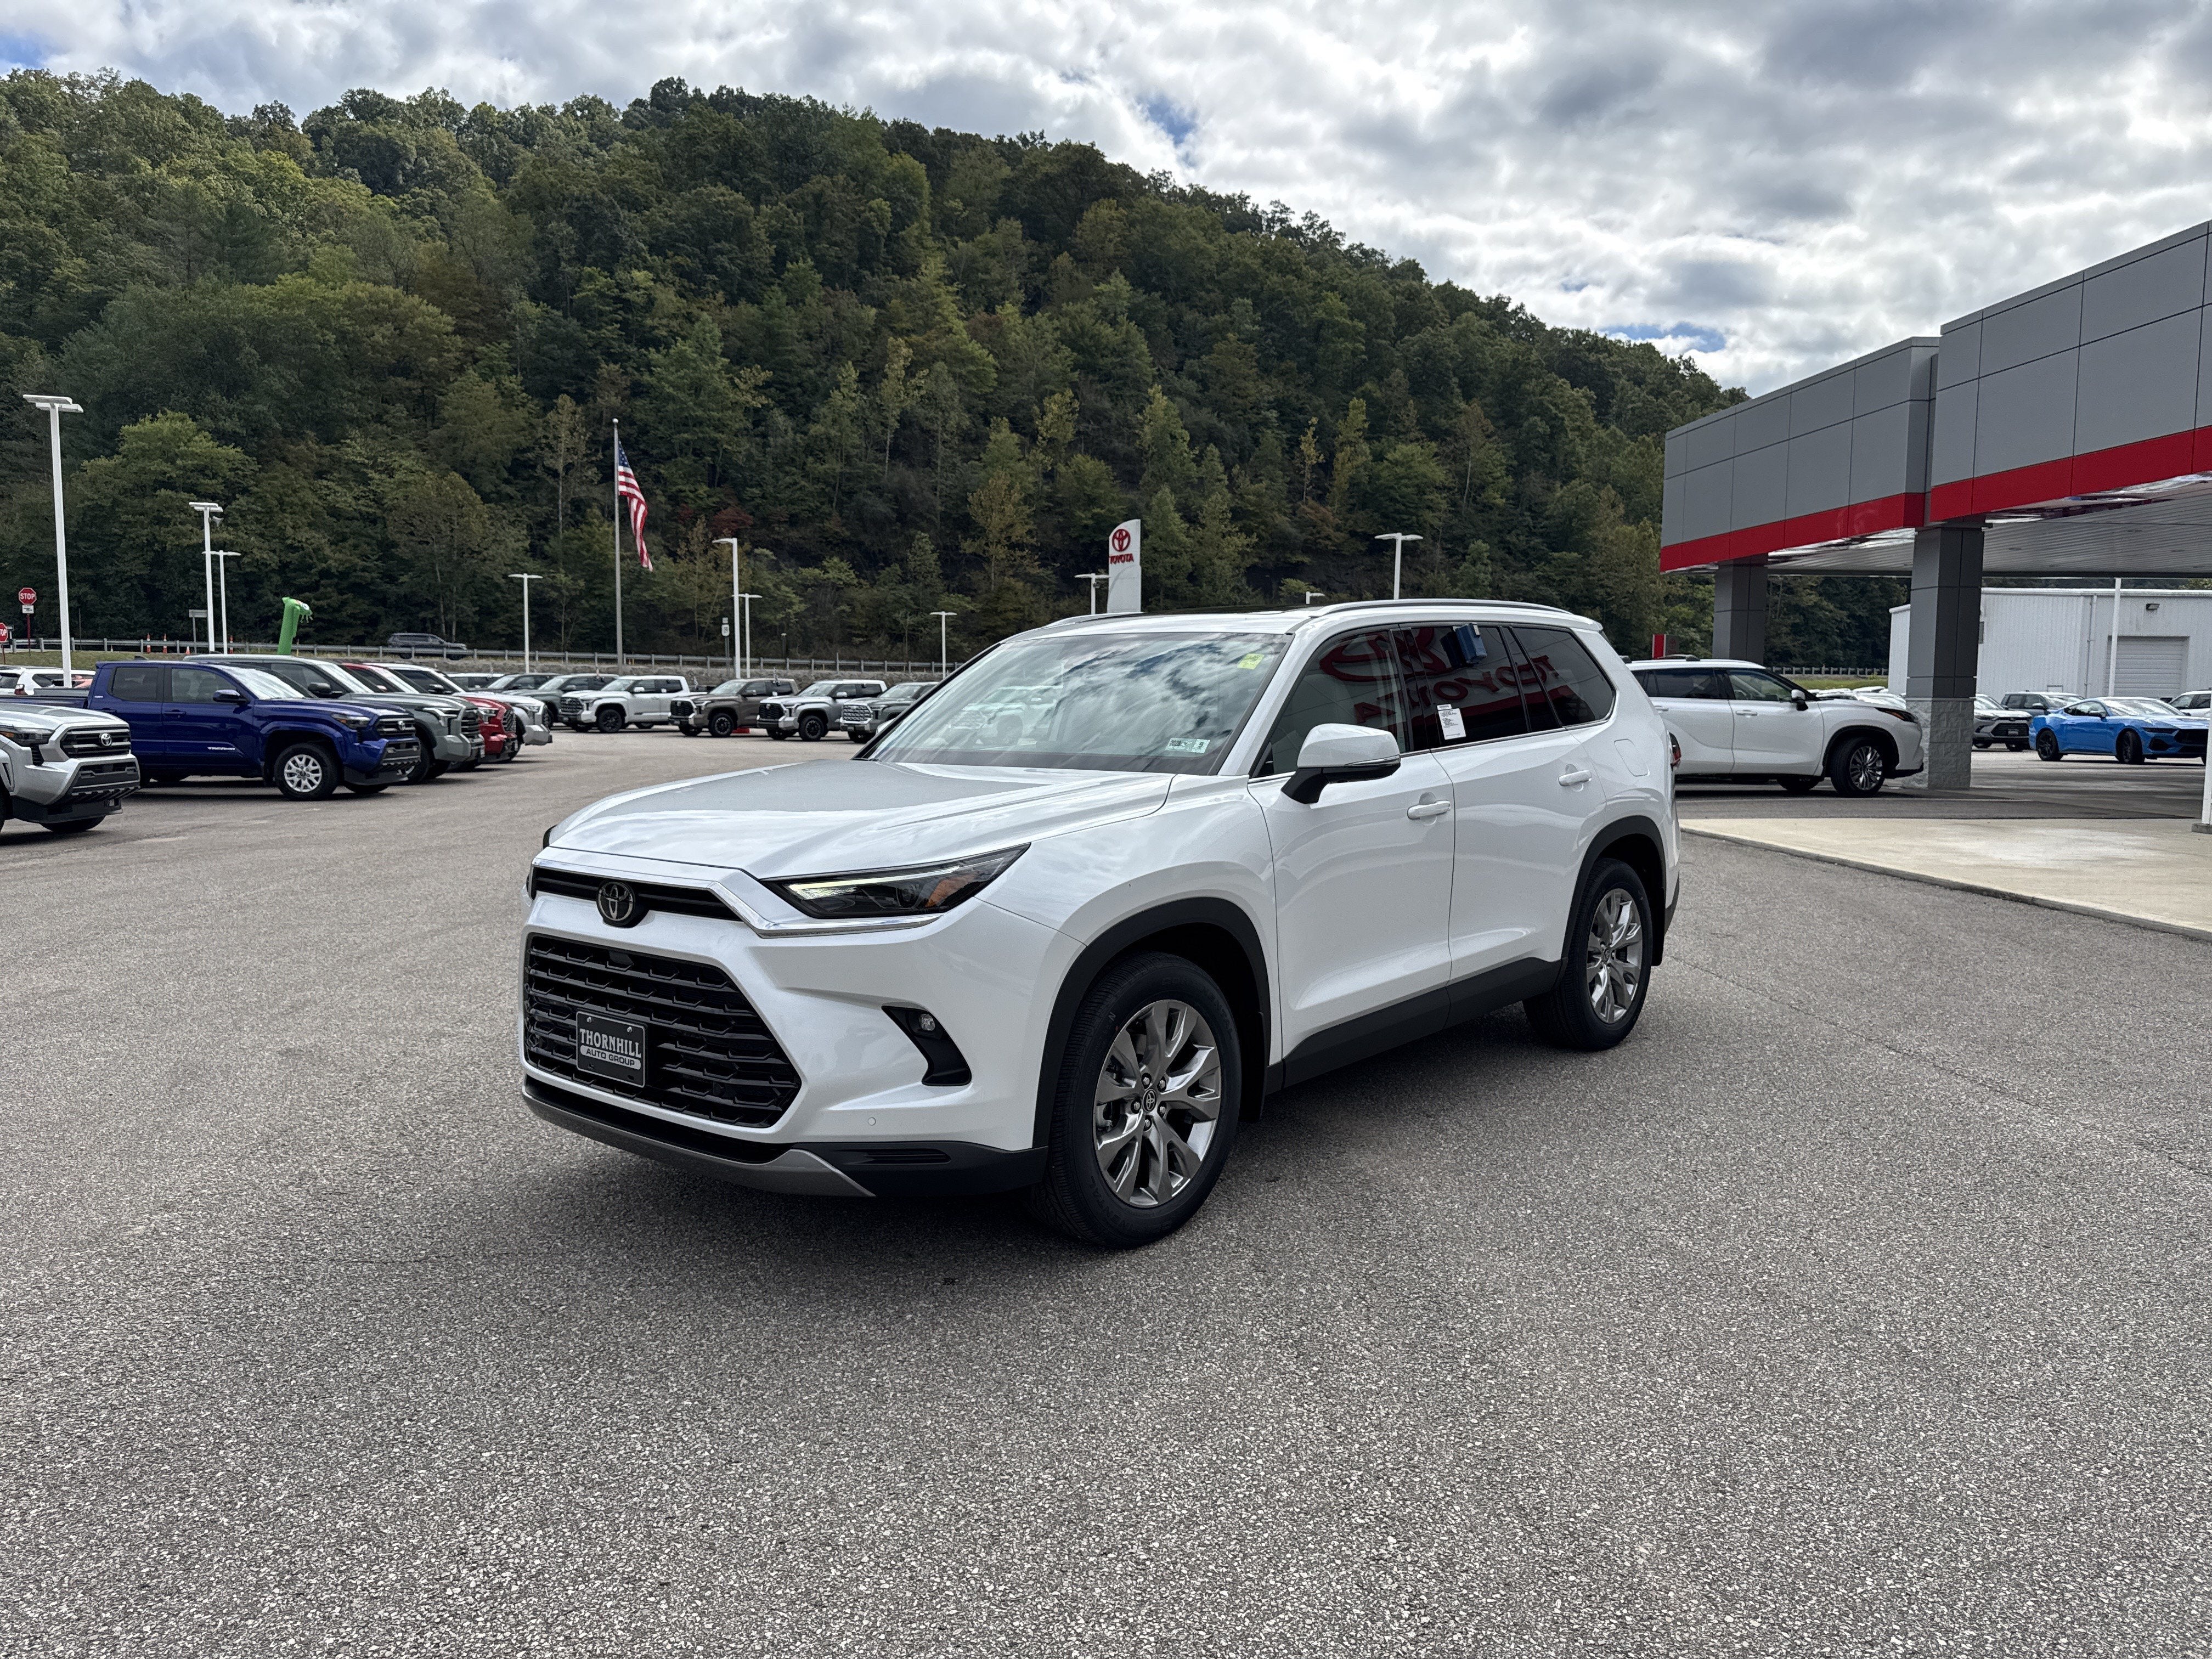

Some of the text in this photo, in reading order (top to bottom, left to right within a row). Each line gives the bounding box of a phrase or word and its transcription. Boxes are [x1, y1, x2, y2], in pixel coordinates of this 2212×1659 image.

[1109, 554, 1134, 564] TOYOTA
[579, 1028, 642, 1058] THORNHILL
[586, 1048, 635, 1066] AUTO GROUP
